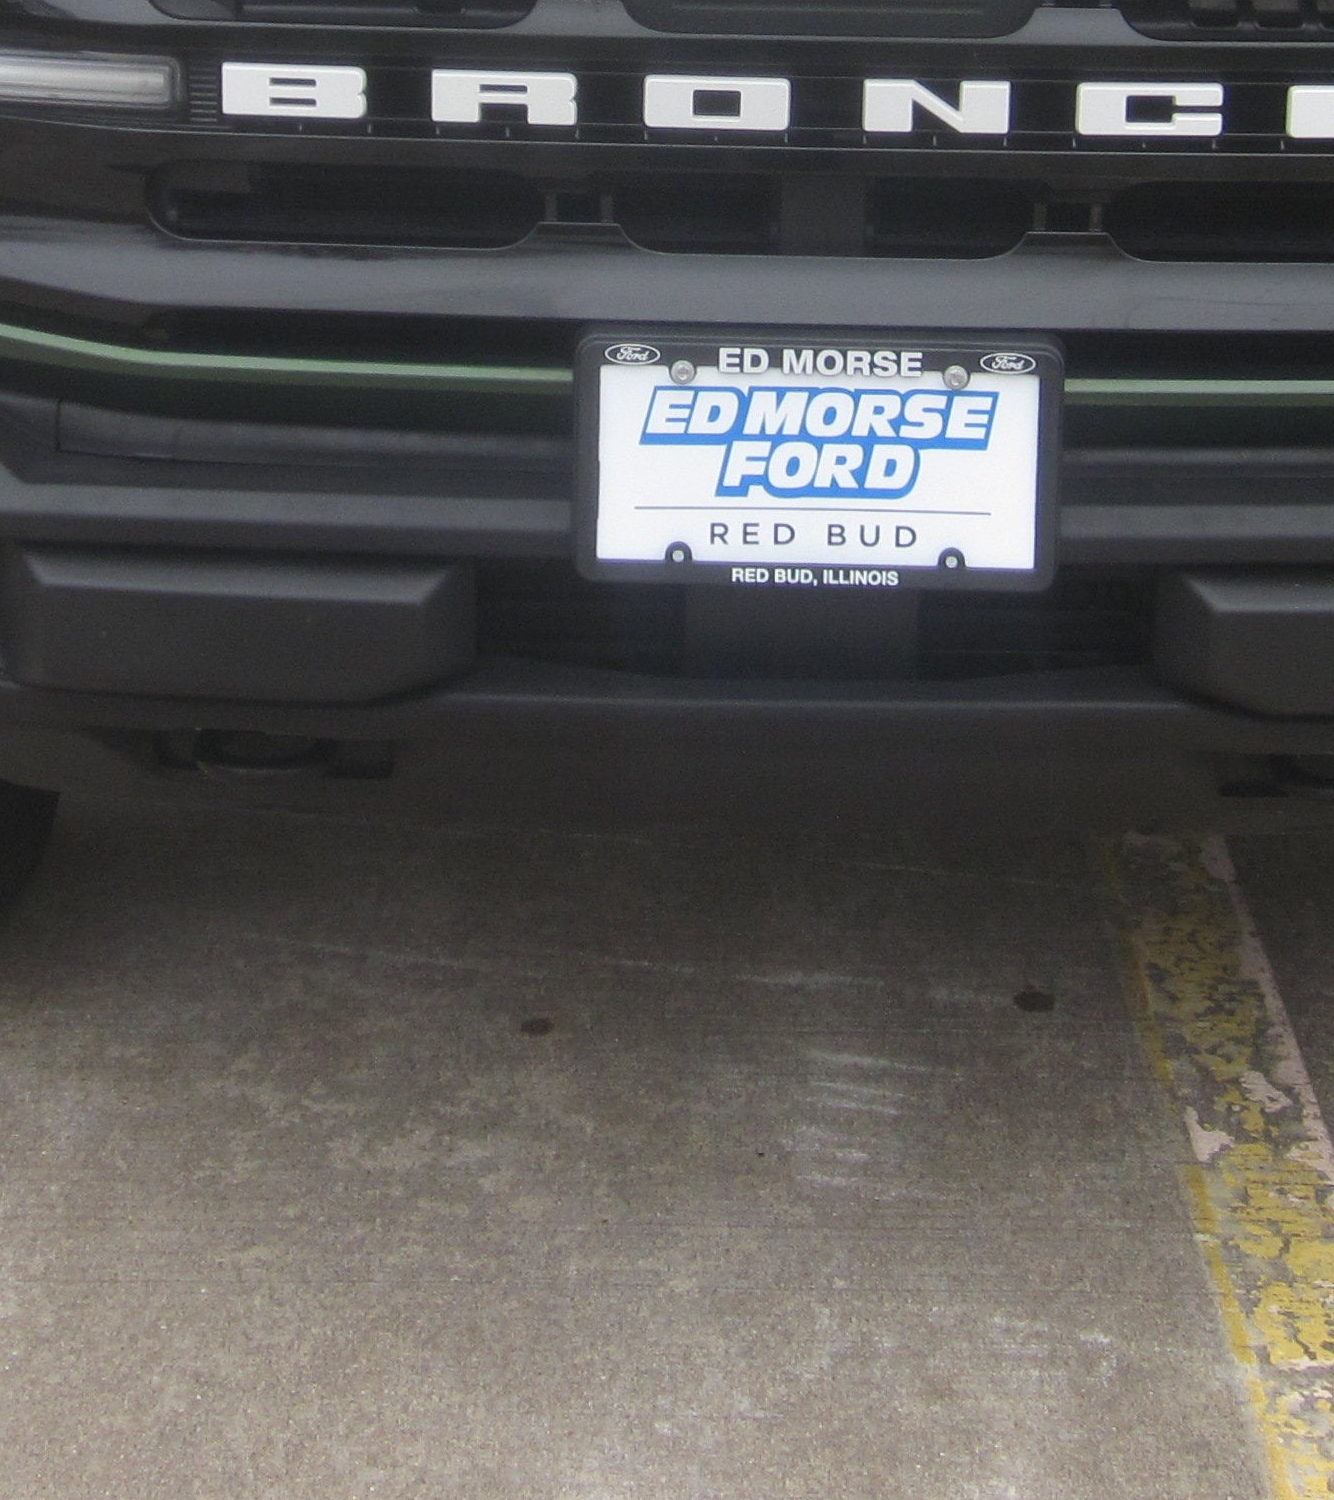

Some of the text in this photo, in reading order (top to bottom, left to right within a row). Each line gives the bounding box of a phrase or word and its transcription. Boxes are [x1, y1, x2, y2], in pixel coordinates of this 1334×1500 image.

[718, 347, 923, 378] ED MORSE
[644, 388, 995, 441] ED MORSE
[721, 441, 917, 492] FORD
[709, 522, 917, 548] RED BUD
[730, 567, 899, 588] RED BUD, ILLINOIS
